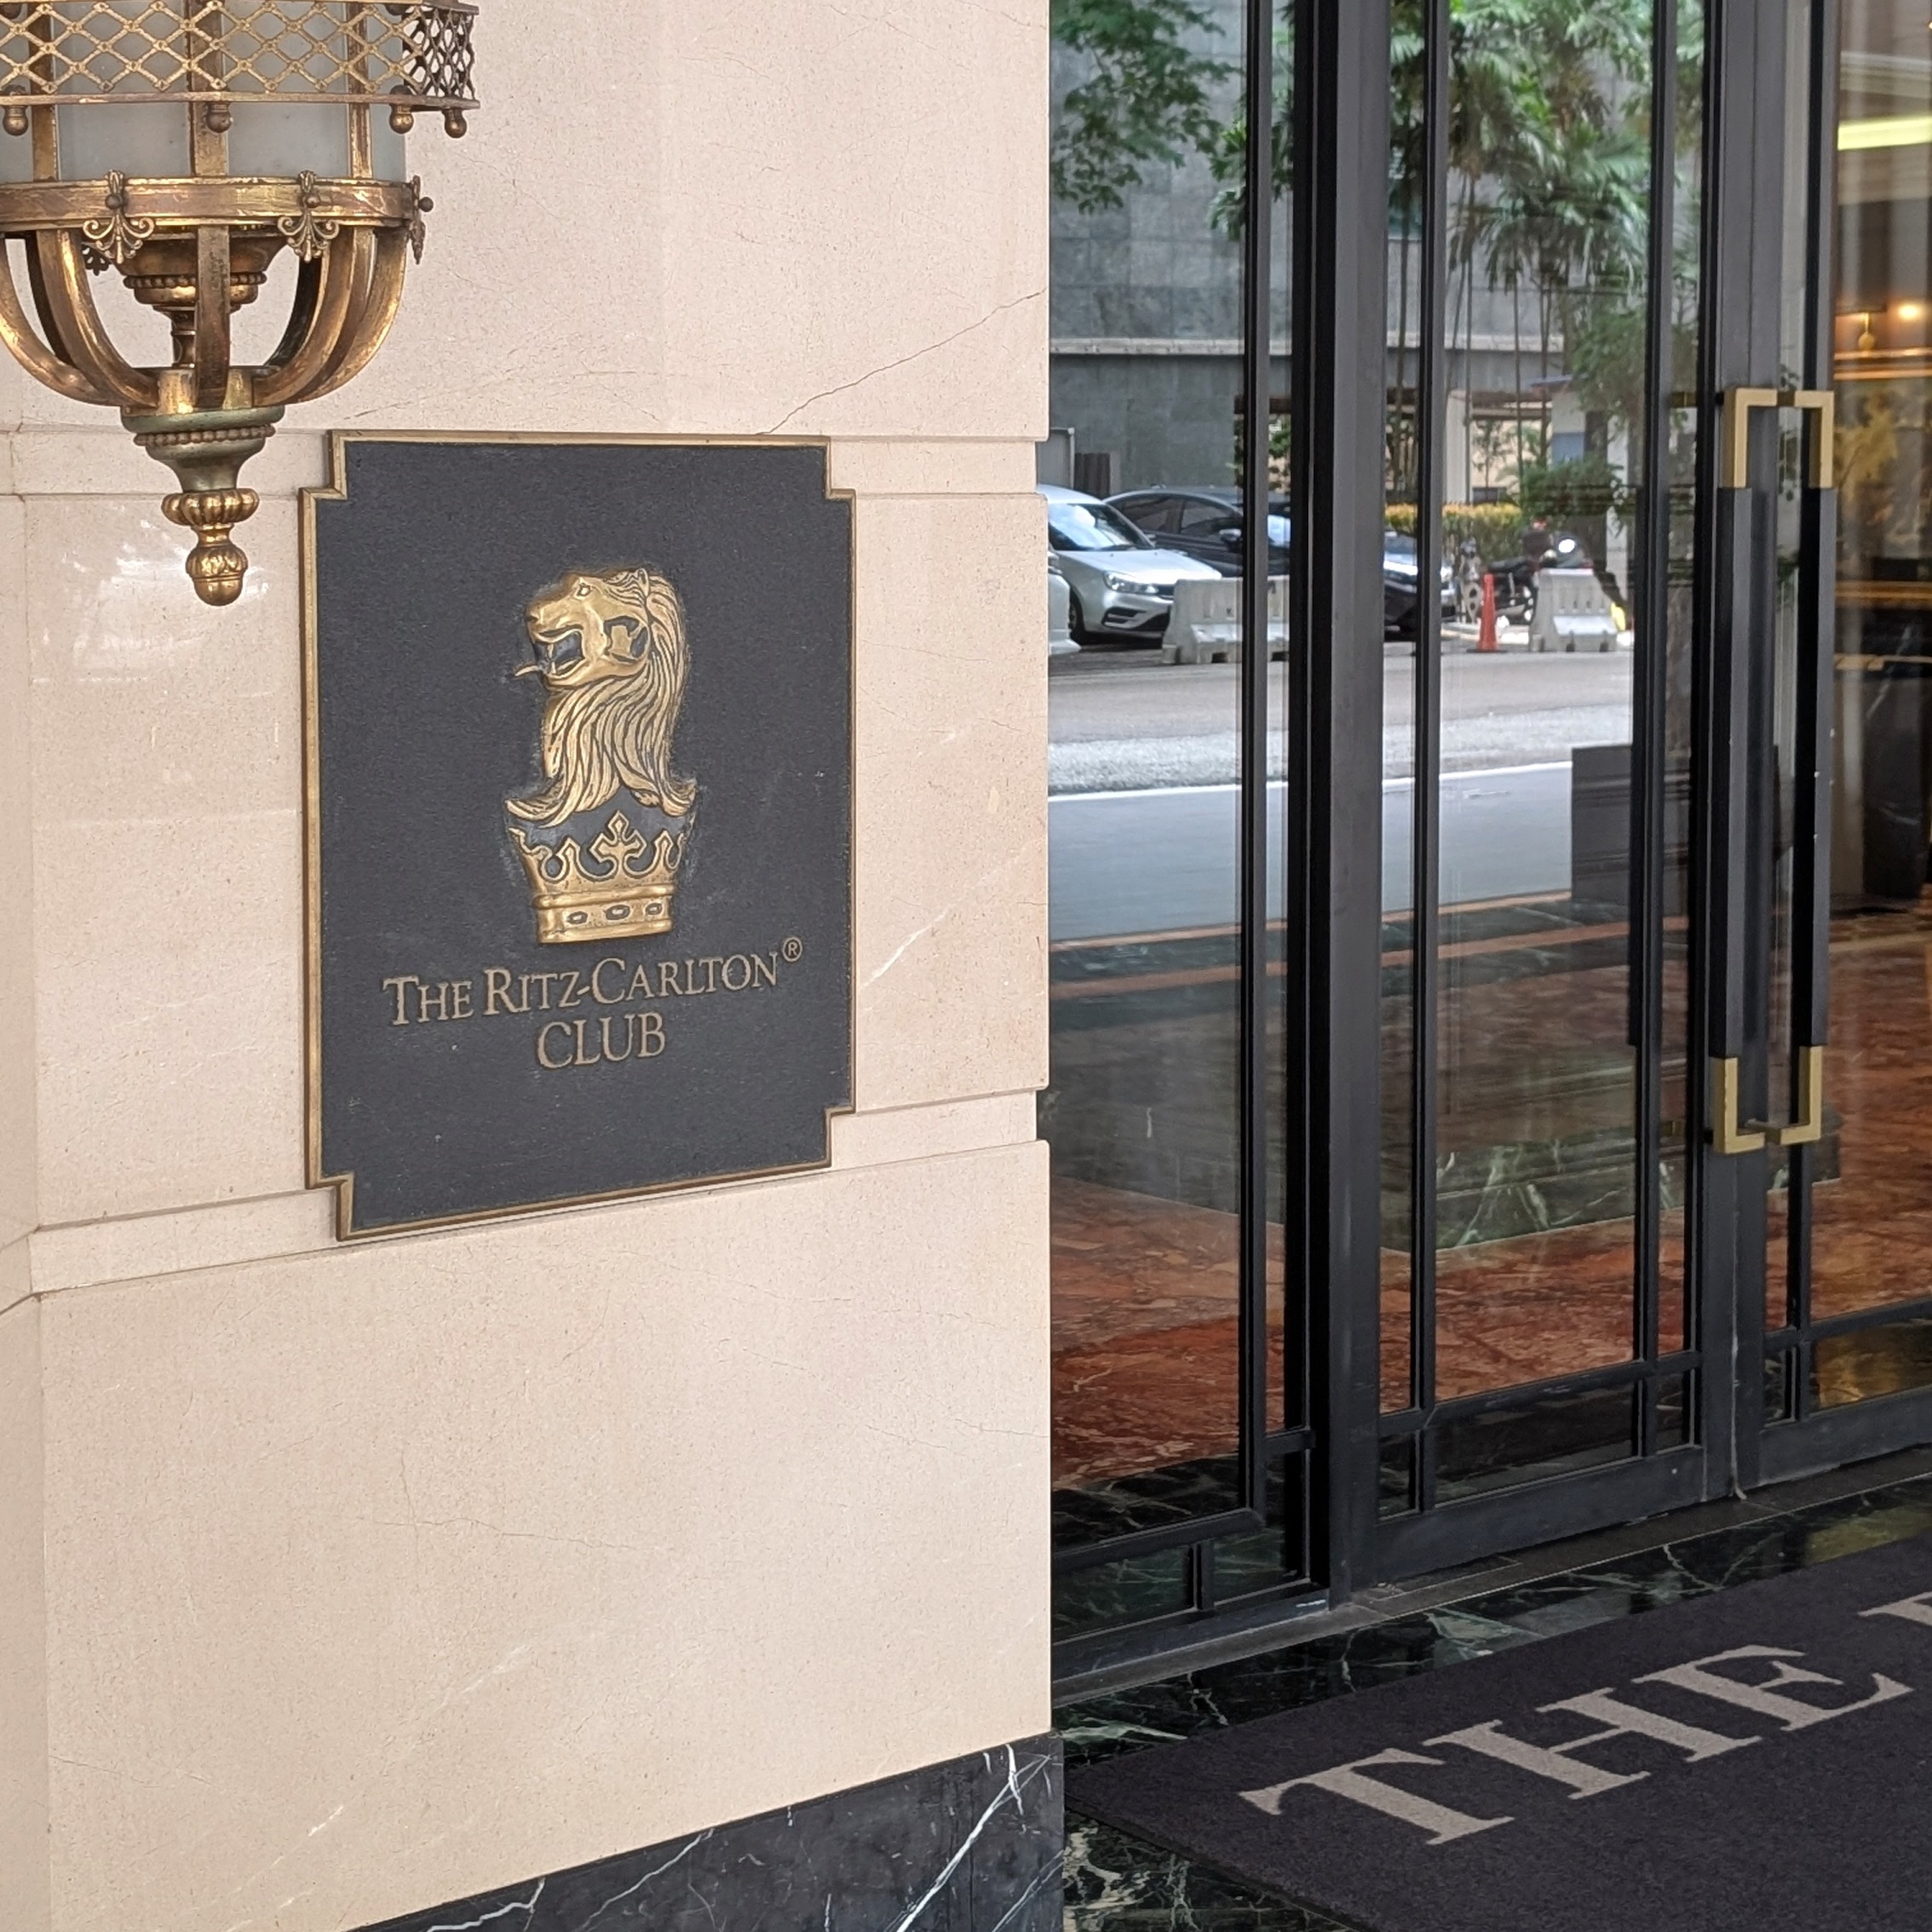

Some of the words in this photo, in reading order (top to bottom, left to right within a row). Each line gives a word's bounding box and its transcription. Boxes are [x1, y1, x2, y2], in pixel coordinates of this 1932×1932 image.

[382, 975, 474, 1026] THE
[537, 1011, 667, 1070] CLUB
[1238, 1644, 1915, 1846] THE
